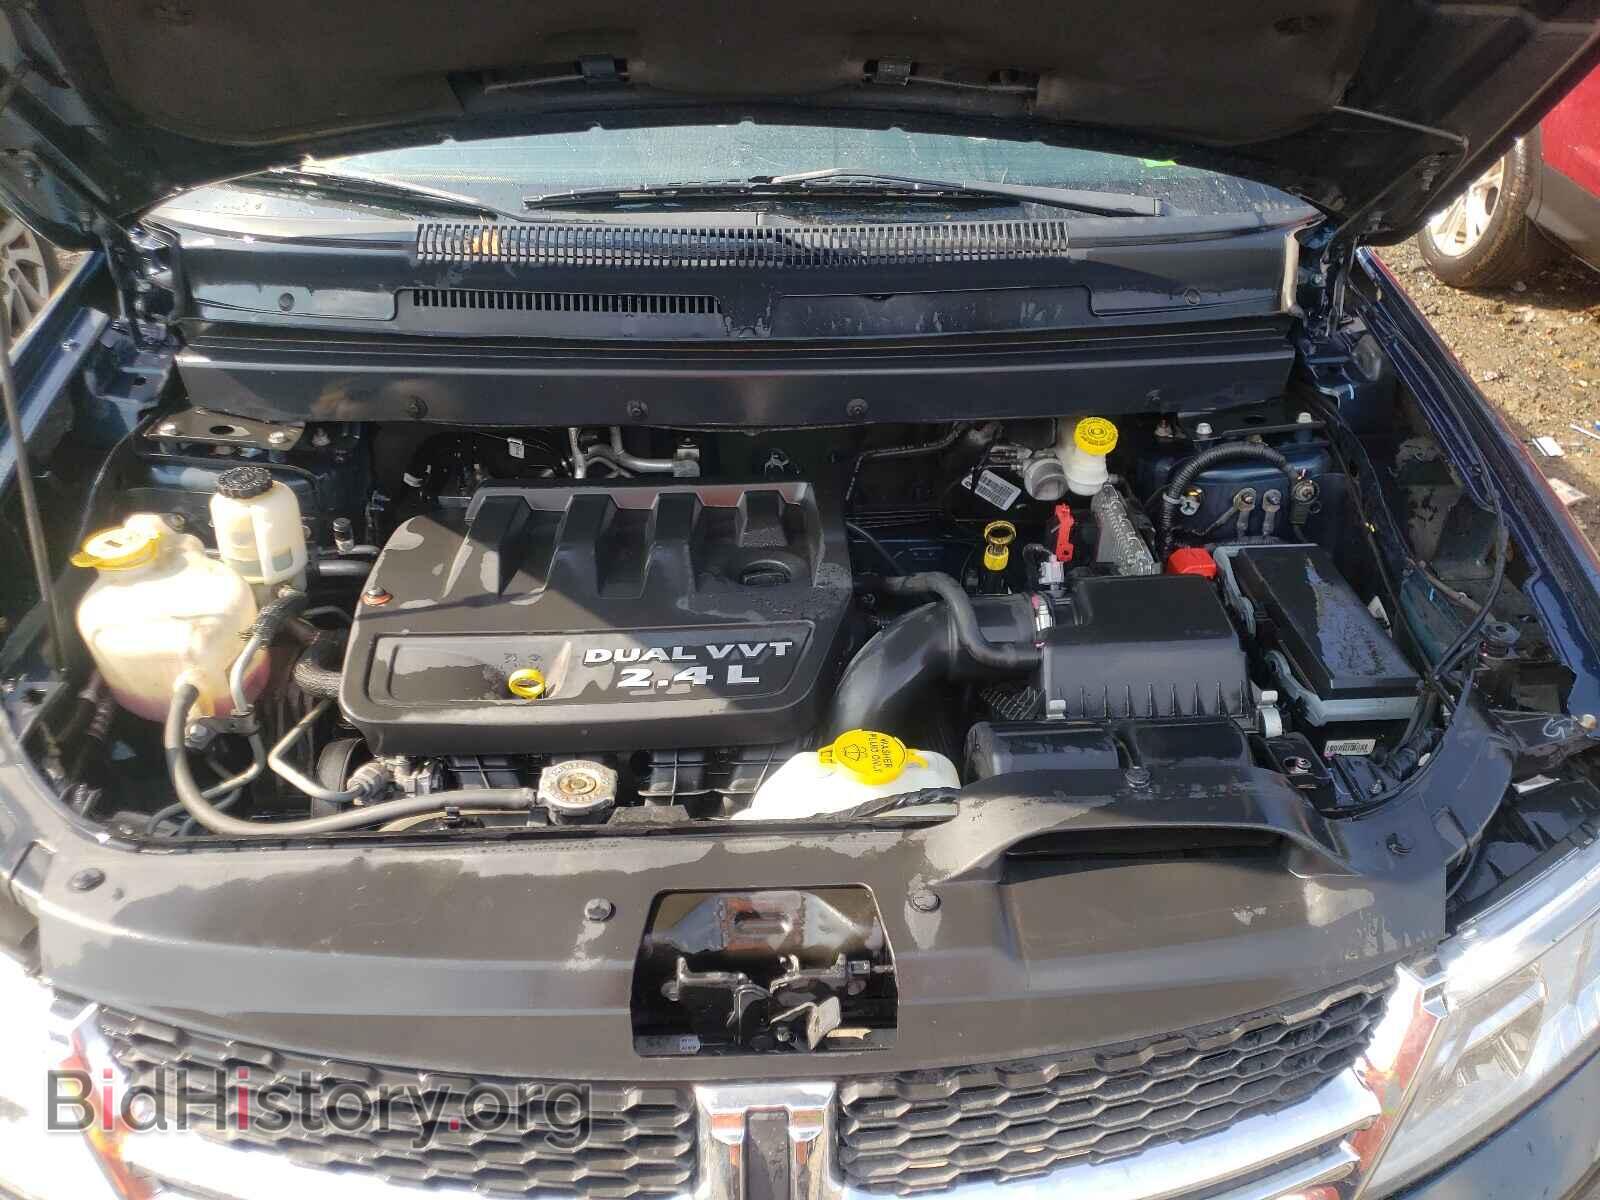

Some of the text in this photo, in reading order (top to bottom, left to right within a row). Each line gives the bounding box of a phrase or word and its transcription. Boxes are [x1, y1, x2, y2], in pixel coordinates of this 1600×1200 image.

[584, 641, 793, 665] DUAL VVT
[617, 664, 760, 689] 2.4 L
[867, 733, 883, 773] FLUID ONLY
[880, 738, 893, 768] WASHER
